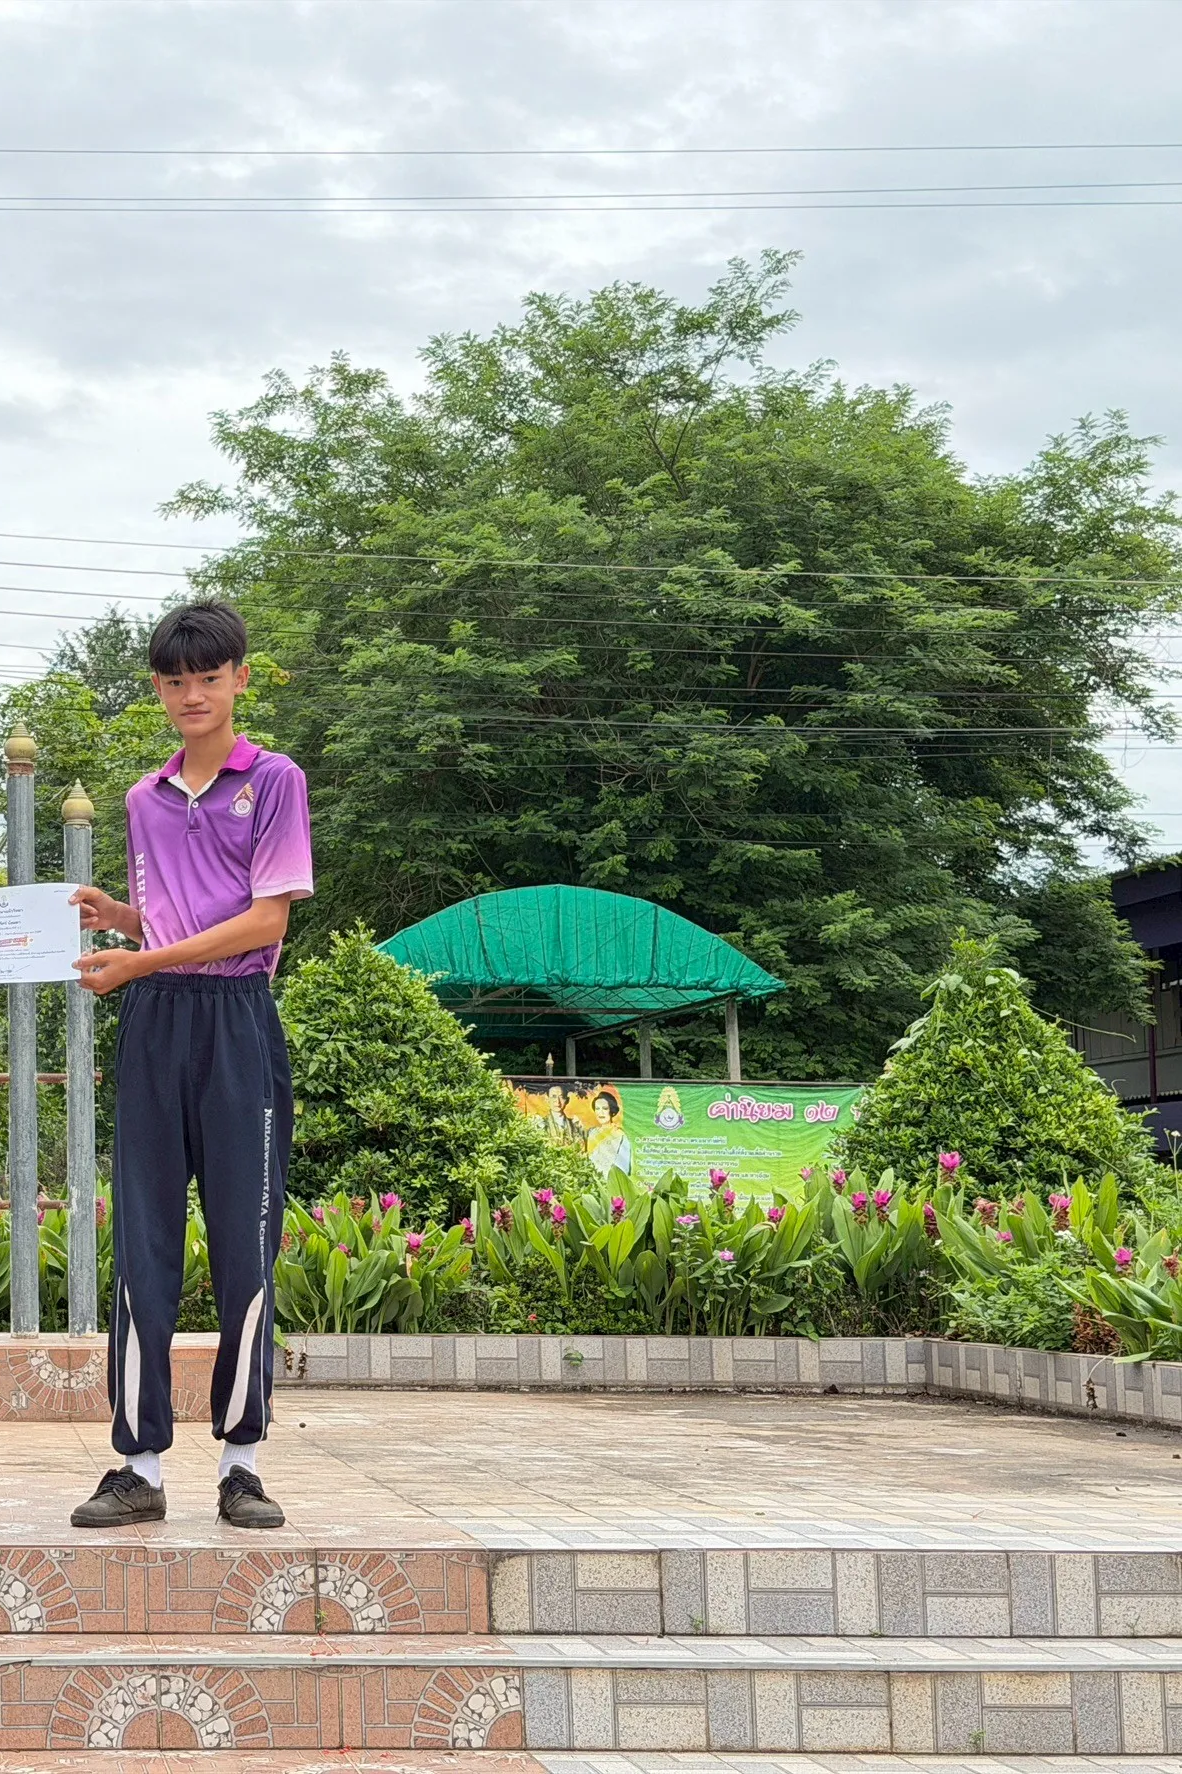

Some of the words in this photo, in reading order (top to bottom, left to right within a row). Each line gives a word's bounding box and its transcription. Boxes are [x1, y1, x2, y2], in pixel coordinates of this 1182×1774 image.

[707, 1093, 794, 1122] ค่านิยม
[804, 1100, 839, 1122] ๑๒
